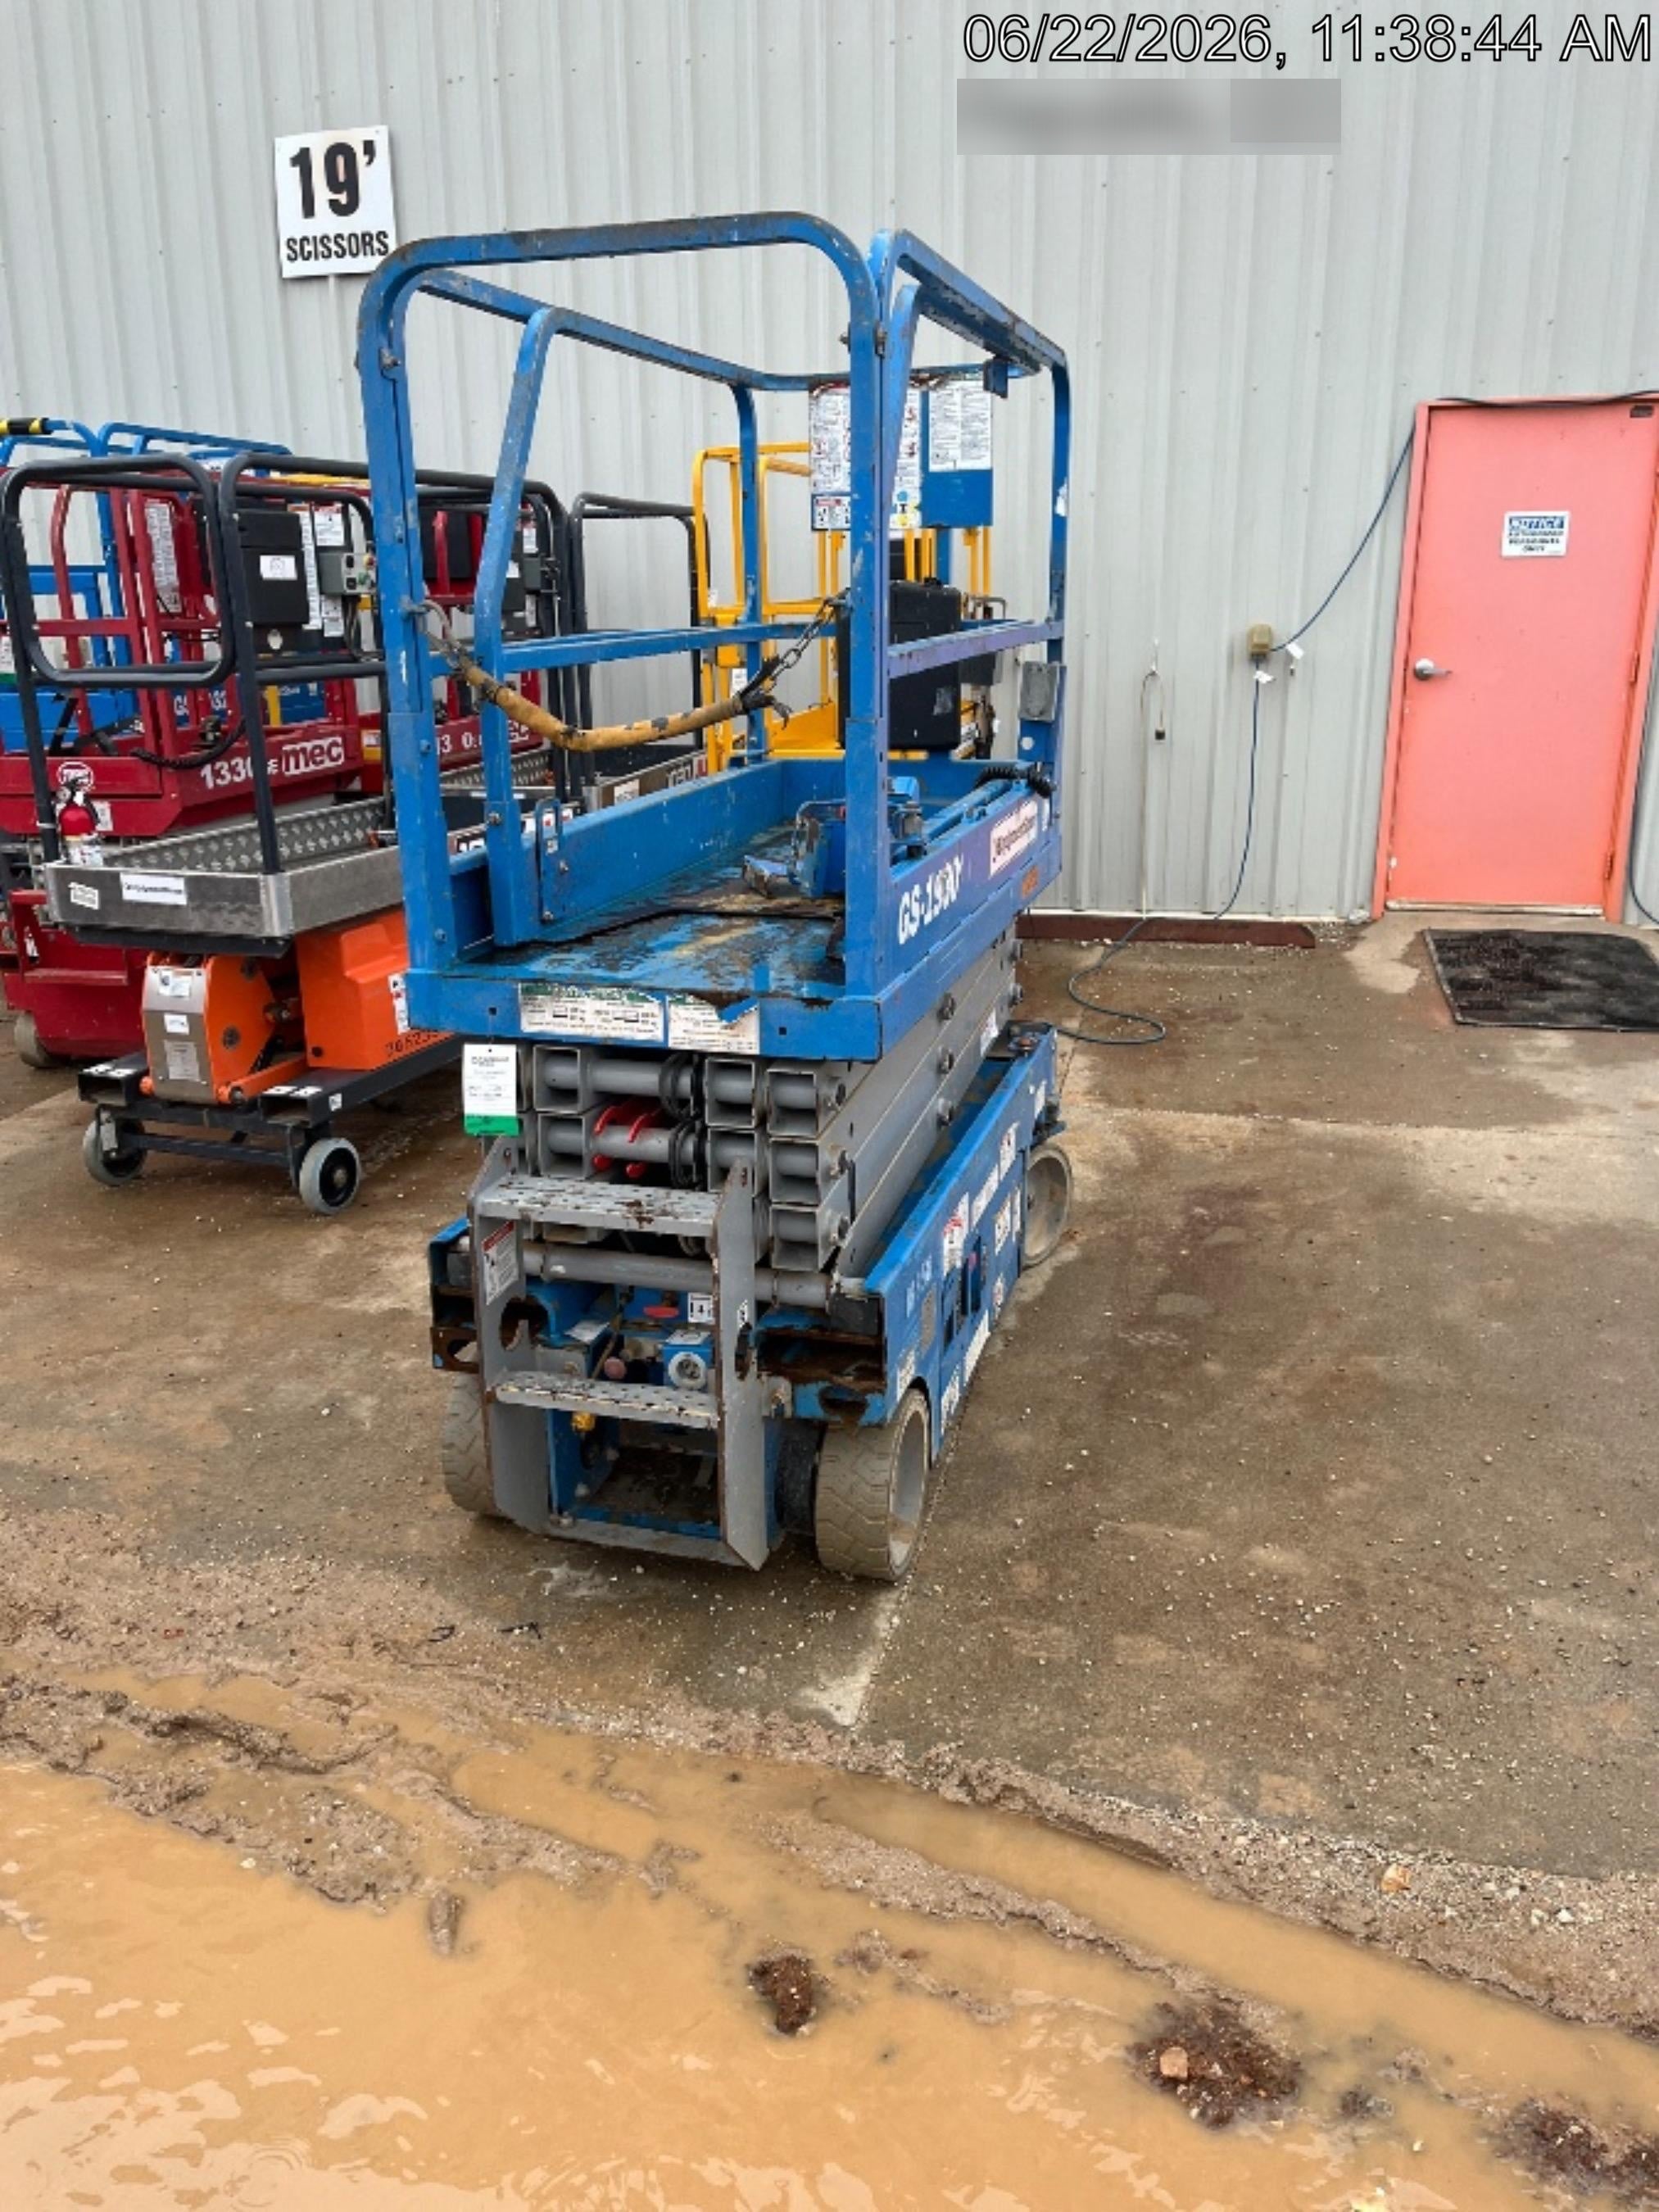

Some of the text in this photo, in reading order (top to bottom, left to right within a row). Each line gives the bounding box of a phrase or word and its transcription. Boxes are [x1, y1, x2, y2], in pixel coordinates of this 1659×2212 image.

[289, 139, 376, 219] 19'
[287, 230, 389, 262] SCISSORS
[283, 737, 344, 775] mec
